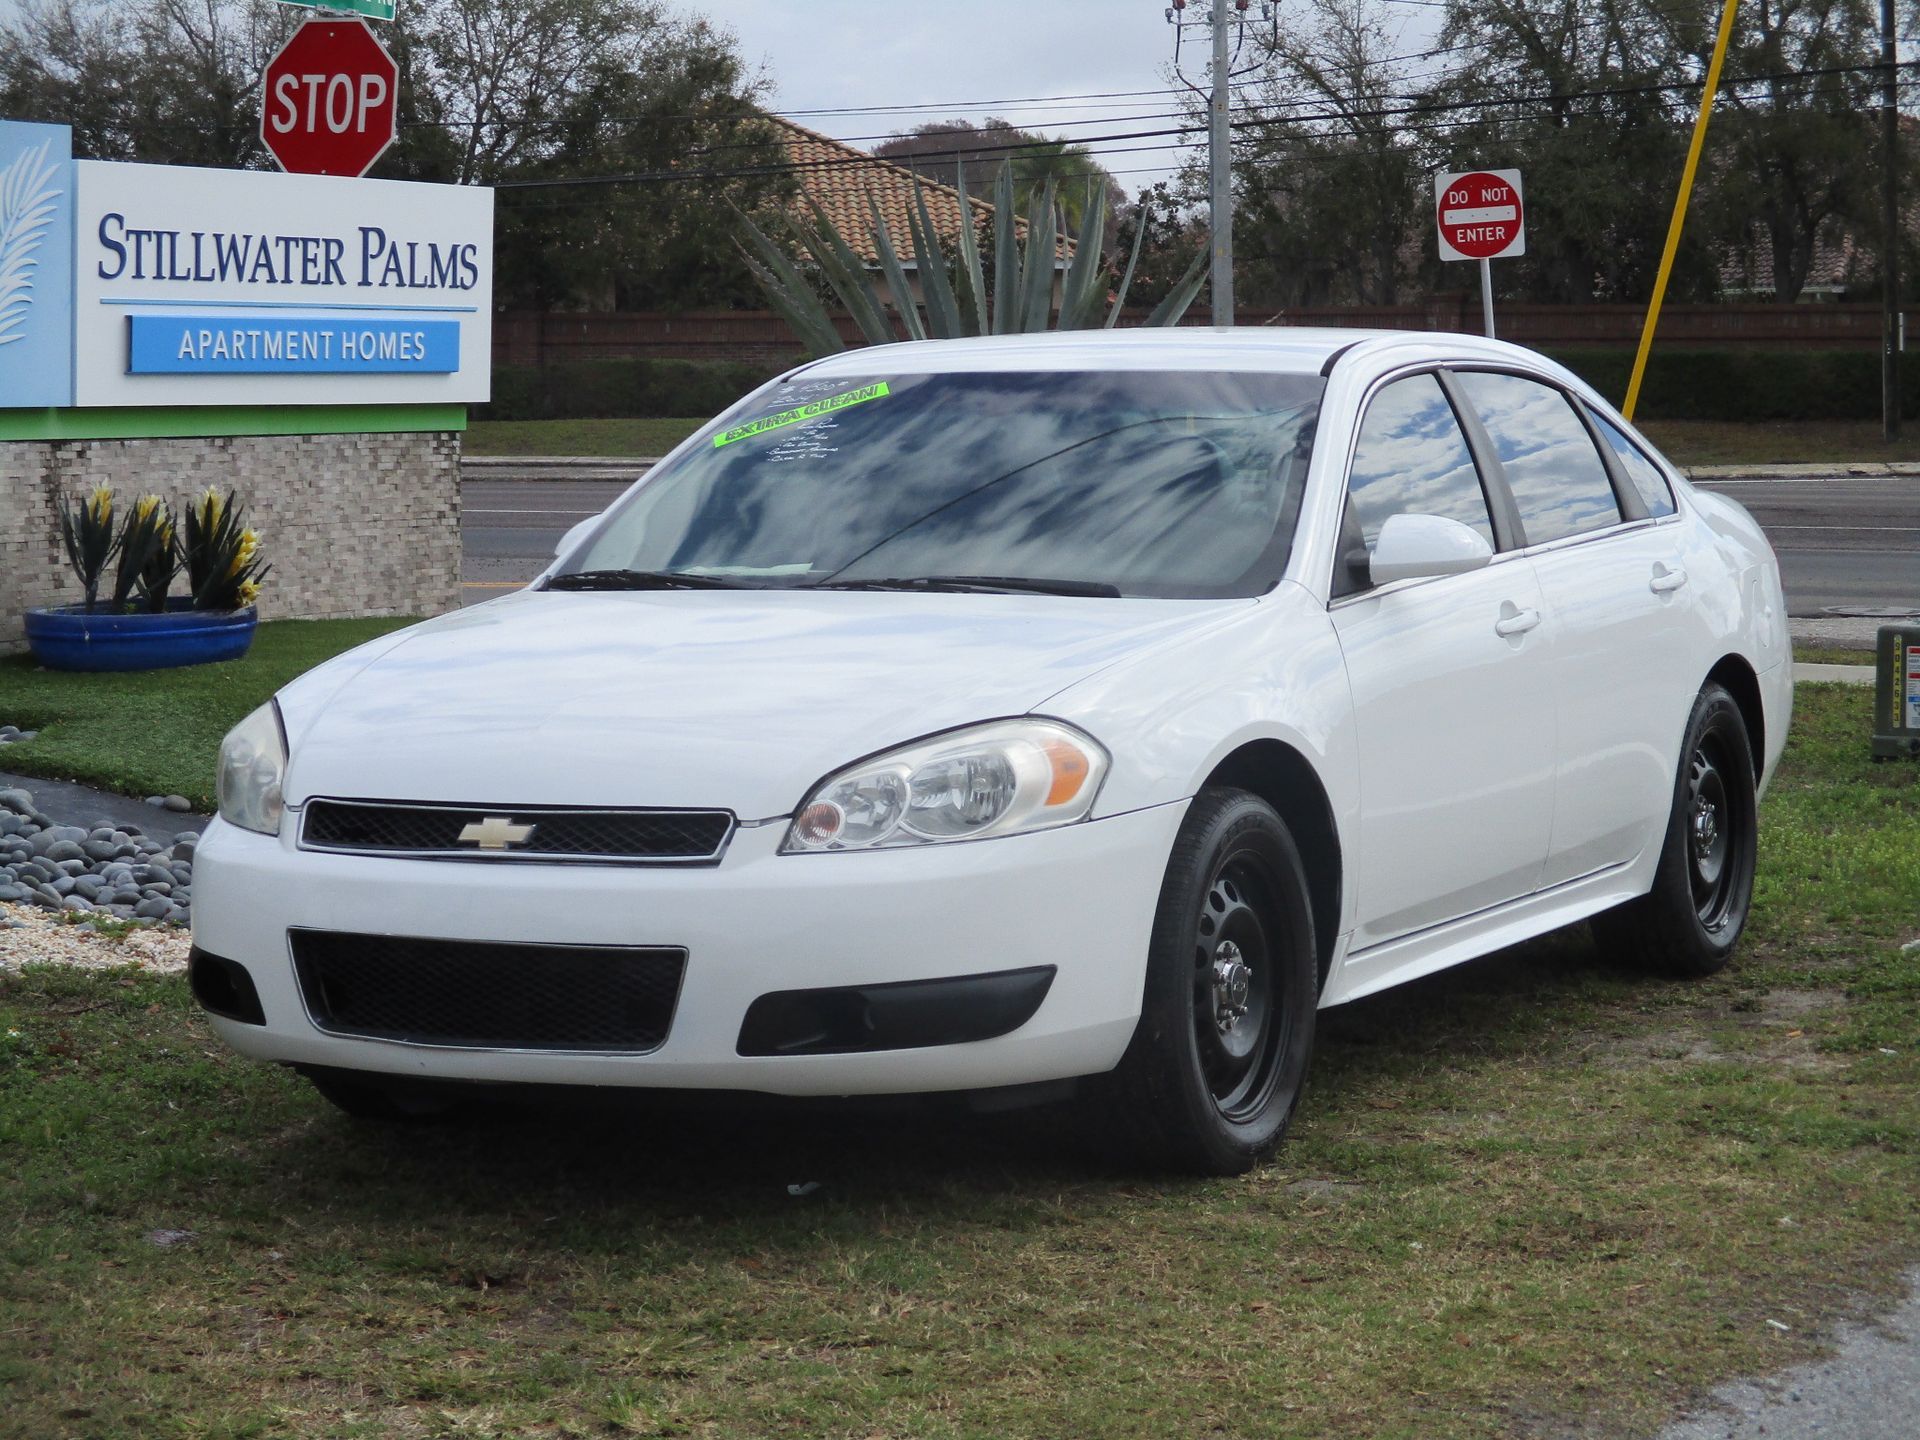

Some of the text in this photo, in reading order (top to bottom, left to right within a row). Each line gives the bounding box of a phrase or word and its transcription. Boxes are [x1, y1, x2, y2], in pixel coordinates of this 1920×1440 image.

[271, 73, 387, 134] STOP
[1449, 187, 1509, 205] DO NOT
[1457, 226, 1506, 243] ENTER
[98, 213, 478, 290] STILLWATER PALMS
[178, 329, 426, 361] APARTMENT HOMES
[725, 409, 801, 441] EXTRA
